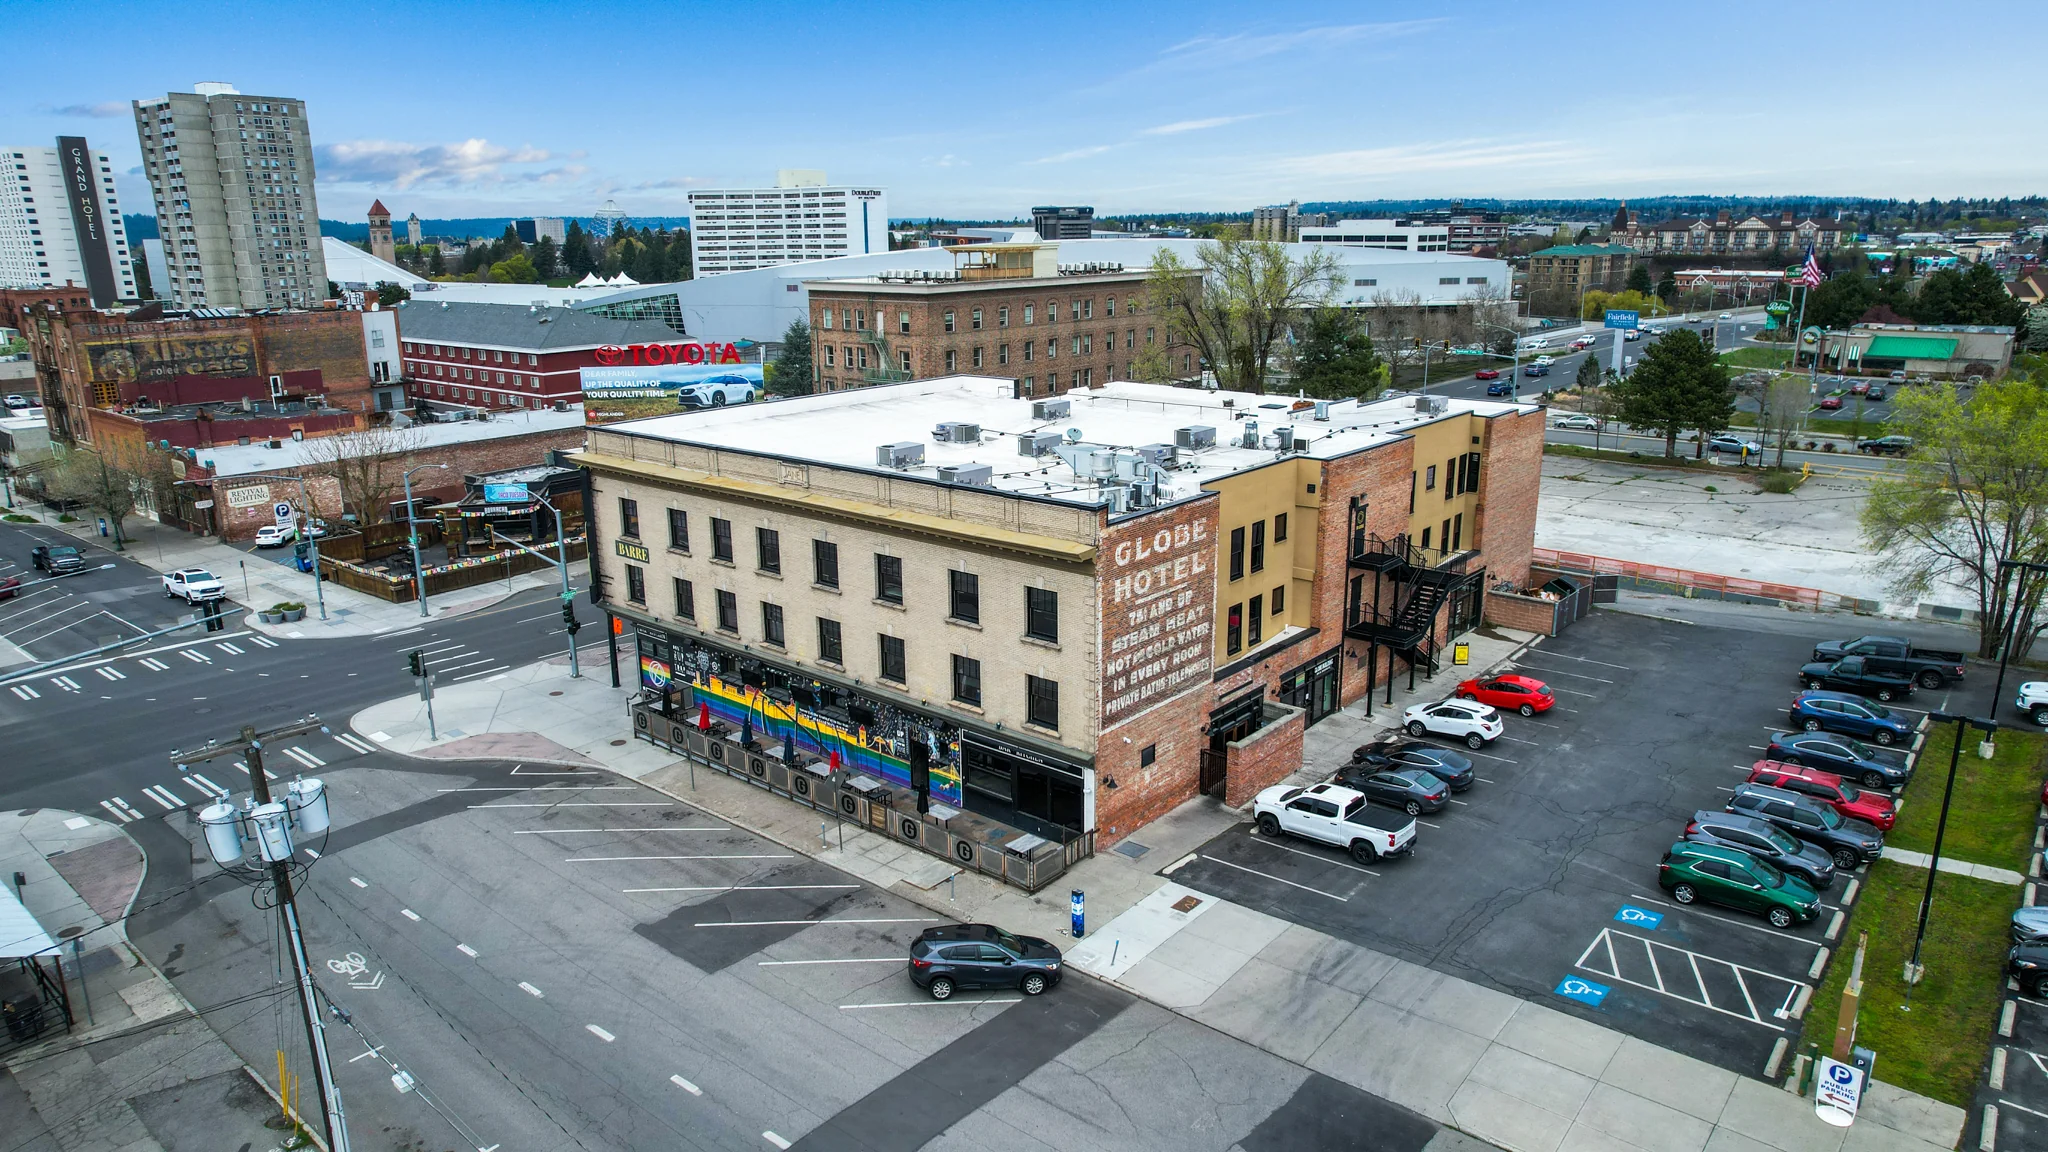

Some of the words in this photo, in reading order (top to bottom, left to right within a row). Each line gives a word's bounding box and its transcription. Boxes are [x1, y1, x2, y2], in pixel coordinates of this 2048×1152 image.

[71, 147, 87, 191] GRAND
[82, 197, 97, 240] HOTEL
[628, 343, 741, 365] TOYOTA
[585, 370, 606, 378] DEAR
[607, 370, 638, 379] FAMILY,
[586, 391, 609, 399] YOUR
[609, 390, 644, 399] QUALITY
[645, 389, 668, 398] TIME.
[598, 380, 614, 388] THE
[615, 380, 649, 389] QUALITY
[650, 380, 661, 388] OF
[229, 493, 269, 504] LIGHTING
[231, 487, 264, 498] REVIVAL
[278, 504, 288, 516] P
[618, 542, 648, 561] BARRE
[1114, 517, 1207, 567] GLOBE
[1114, 551, 1206, 603] HOTEL
[1150, 598, 1173, 619] AND
[1177, 590, 1193, 608] UP
[1112, 623, 1160, 654] STEAM
[1166, 604, 1206, 632] HEAT
[1177, 622, 1210, 645] WATER
[1113, 676, 1126, 692] IN
[1130, 656, 1169, 685] EVERY
[1173, 643, 1202, 666] ROOM
[1106, 689, 1140, 716] PRIVATE
[1834, 1066, 1850, 1081] P
[1820, 1084, 1855, 1101] PARKING
[1824, 1080, 1853, 1094] PUBLIC
